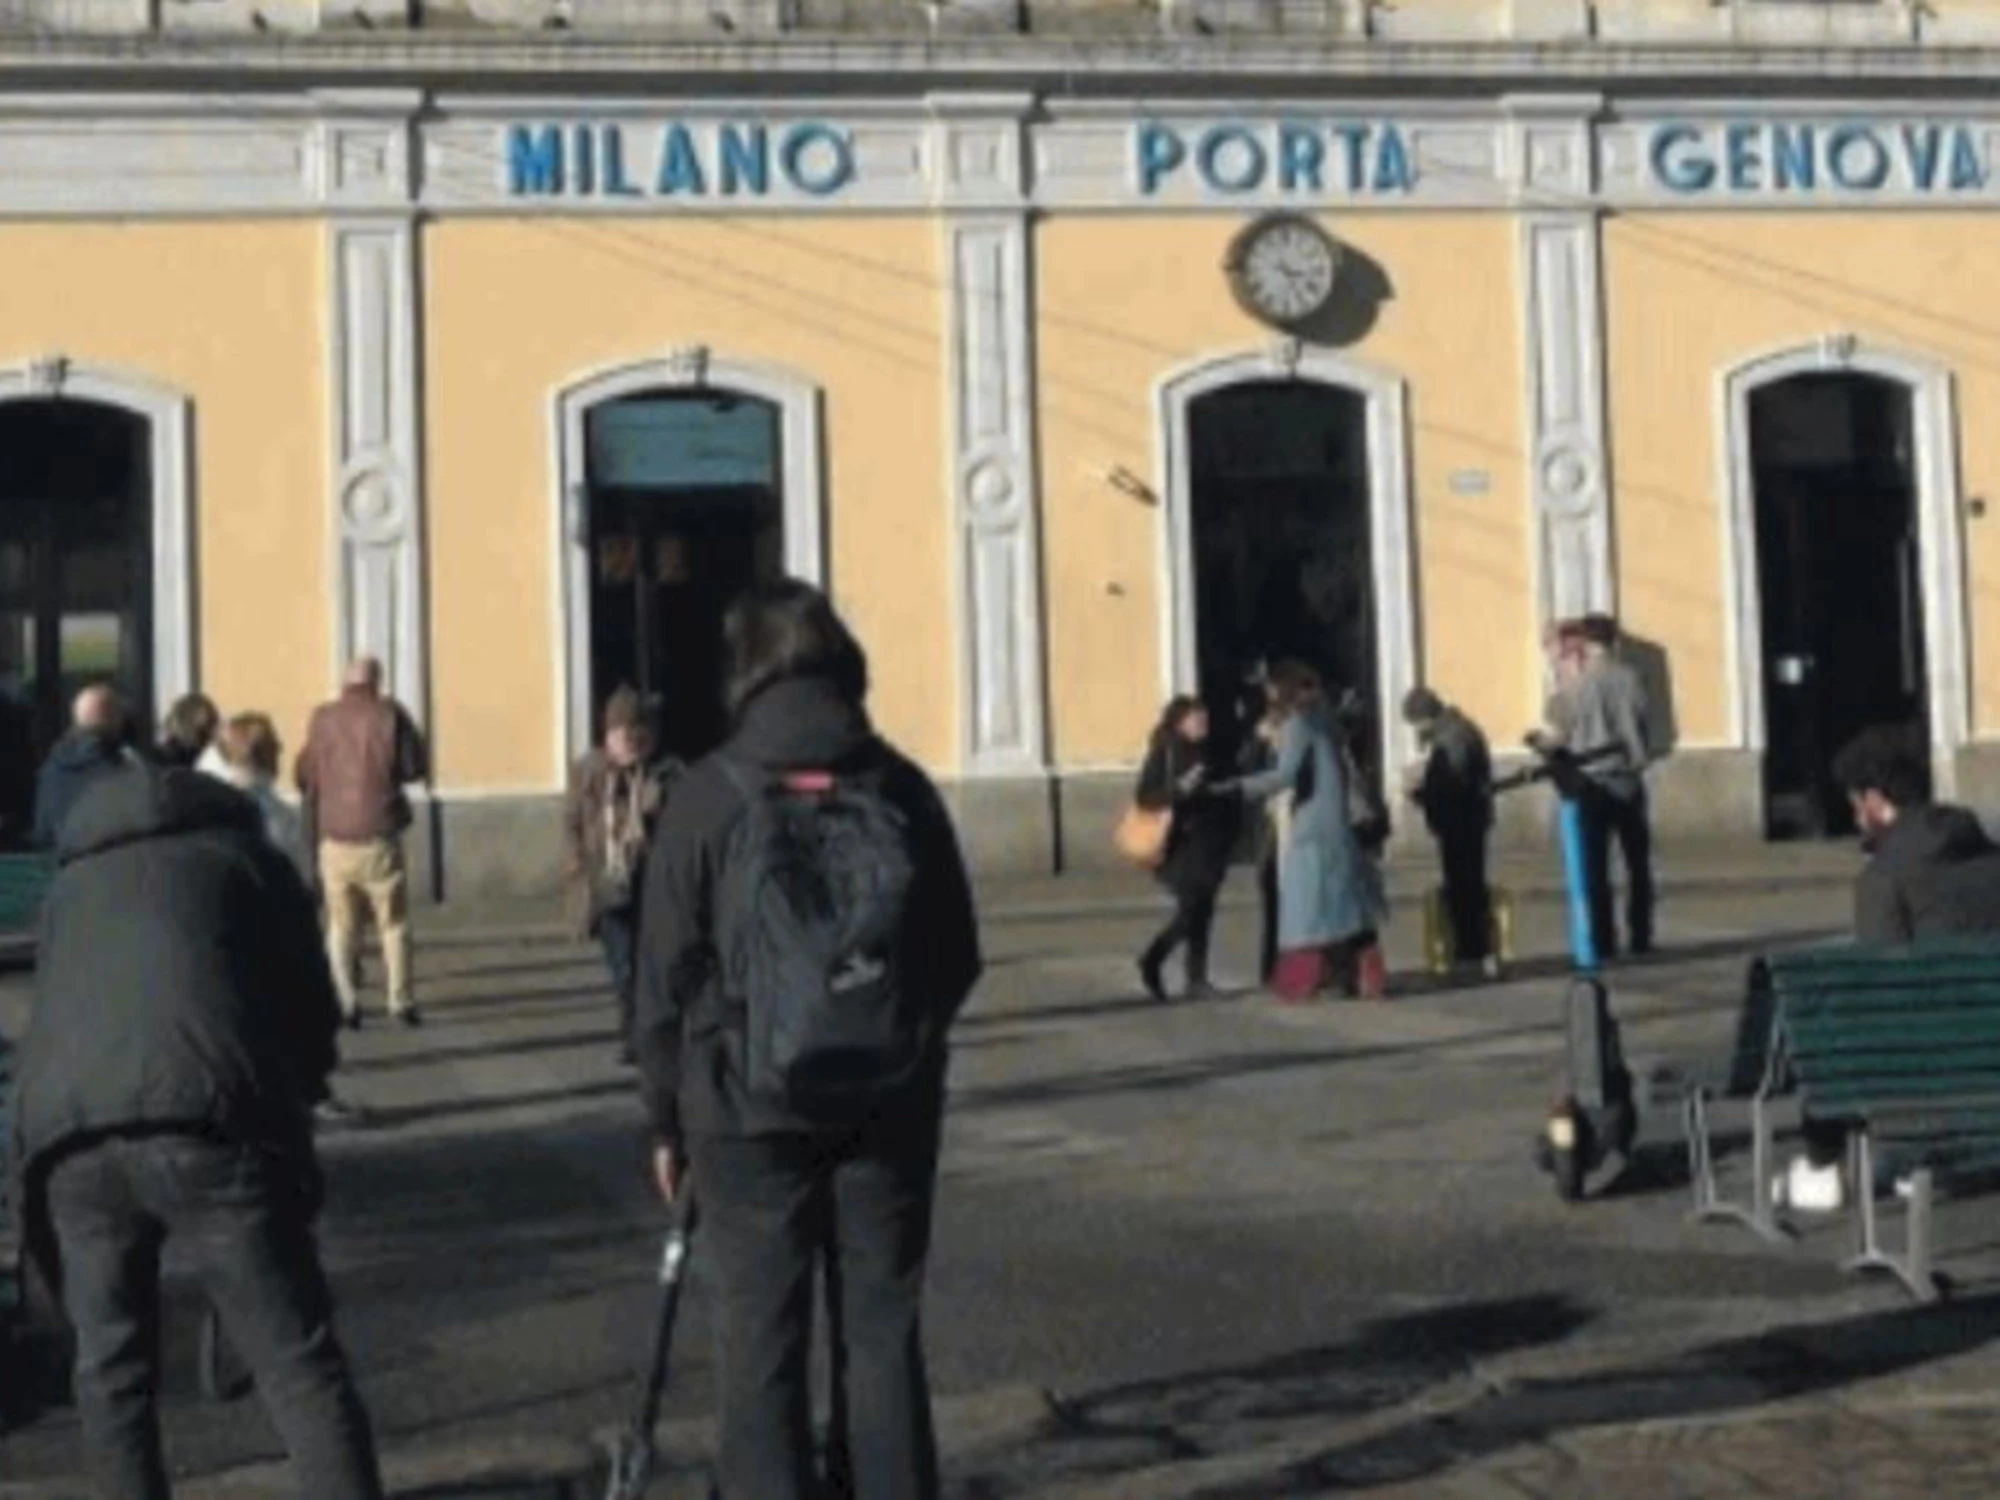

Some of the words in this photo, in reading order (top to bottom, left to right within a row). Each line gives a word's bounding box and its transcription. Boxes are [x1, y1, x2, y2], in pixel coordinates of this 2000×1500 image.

[507, 121, 855, 196] MILANO
[1136, 121, 1415, 195] PORTA
[1650, 121, 1986, 194] GENOVA
